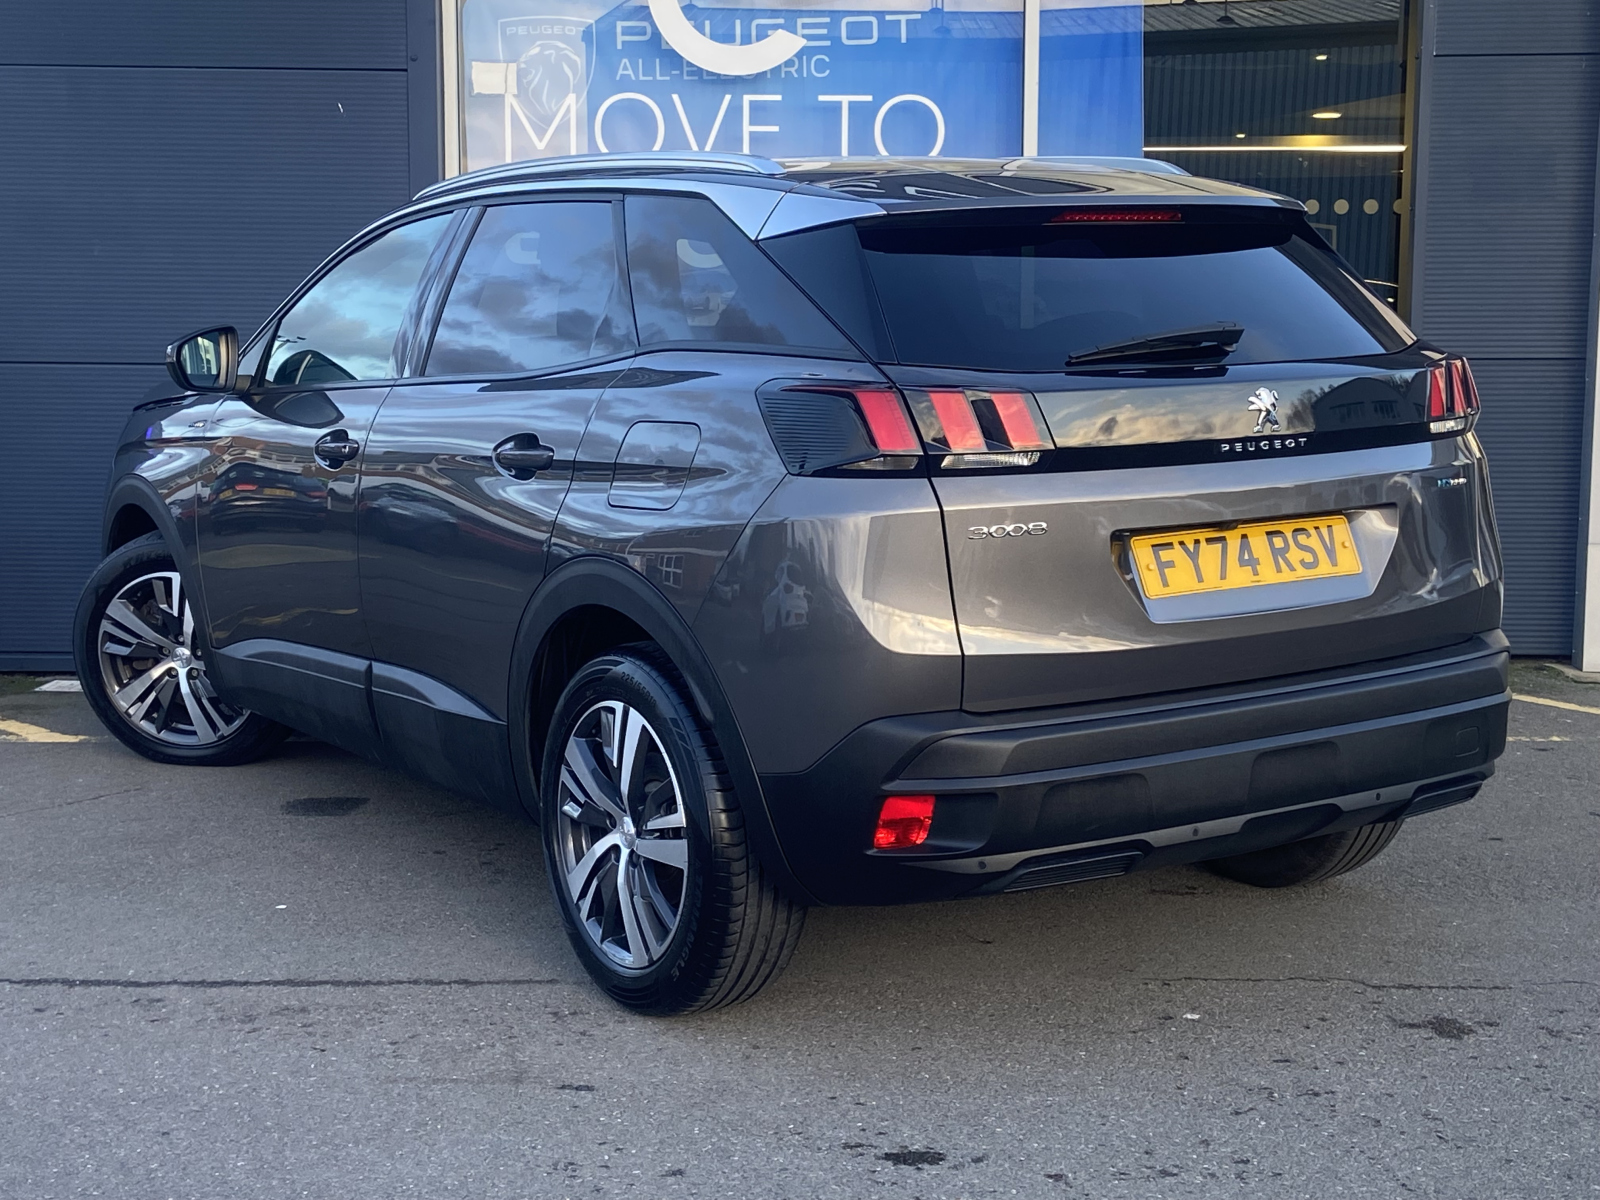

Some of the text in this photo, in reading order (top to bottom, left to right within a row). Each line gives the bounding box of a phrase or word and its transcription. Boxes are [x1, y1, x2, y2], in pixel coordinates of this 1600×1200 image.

[615, 14, 922, 50] PUGEOT
[615, 54, 831, 81] ALL-ELRIC
[504, 91, 946, 163] MOVE TO
[1221, 438, 1307, 453] PEUGEOT
[968, 521, 1049, 540] 3008
[1150, 524, 1339, 589] FY74 RSV
